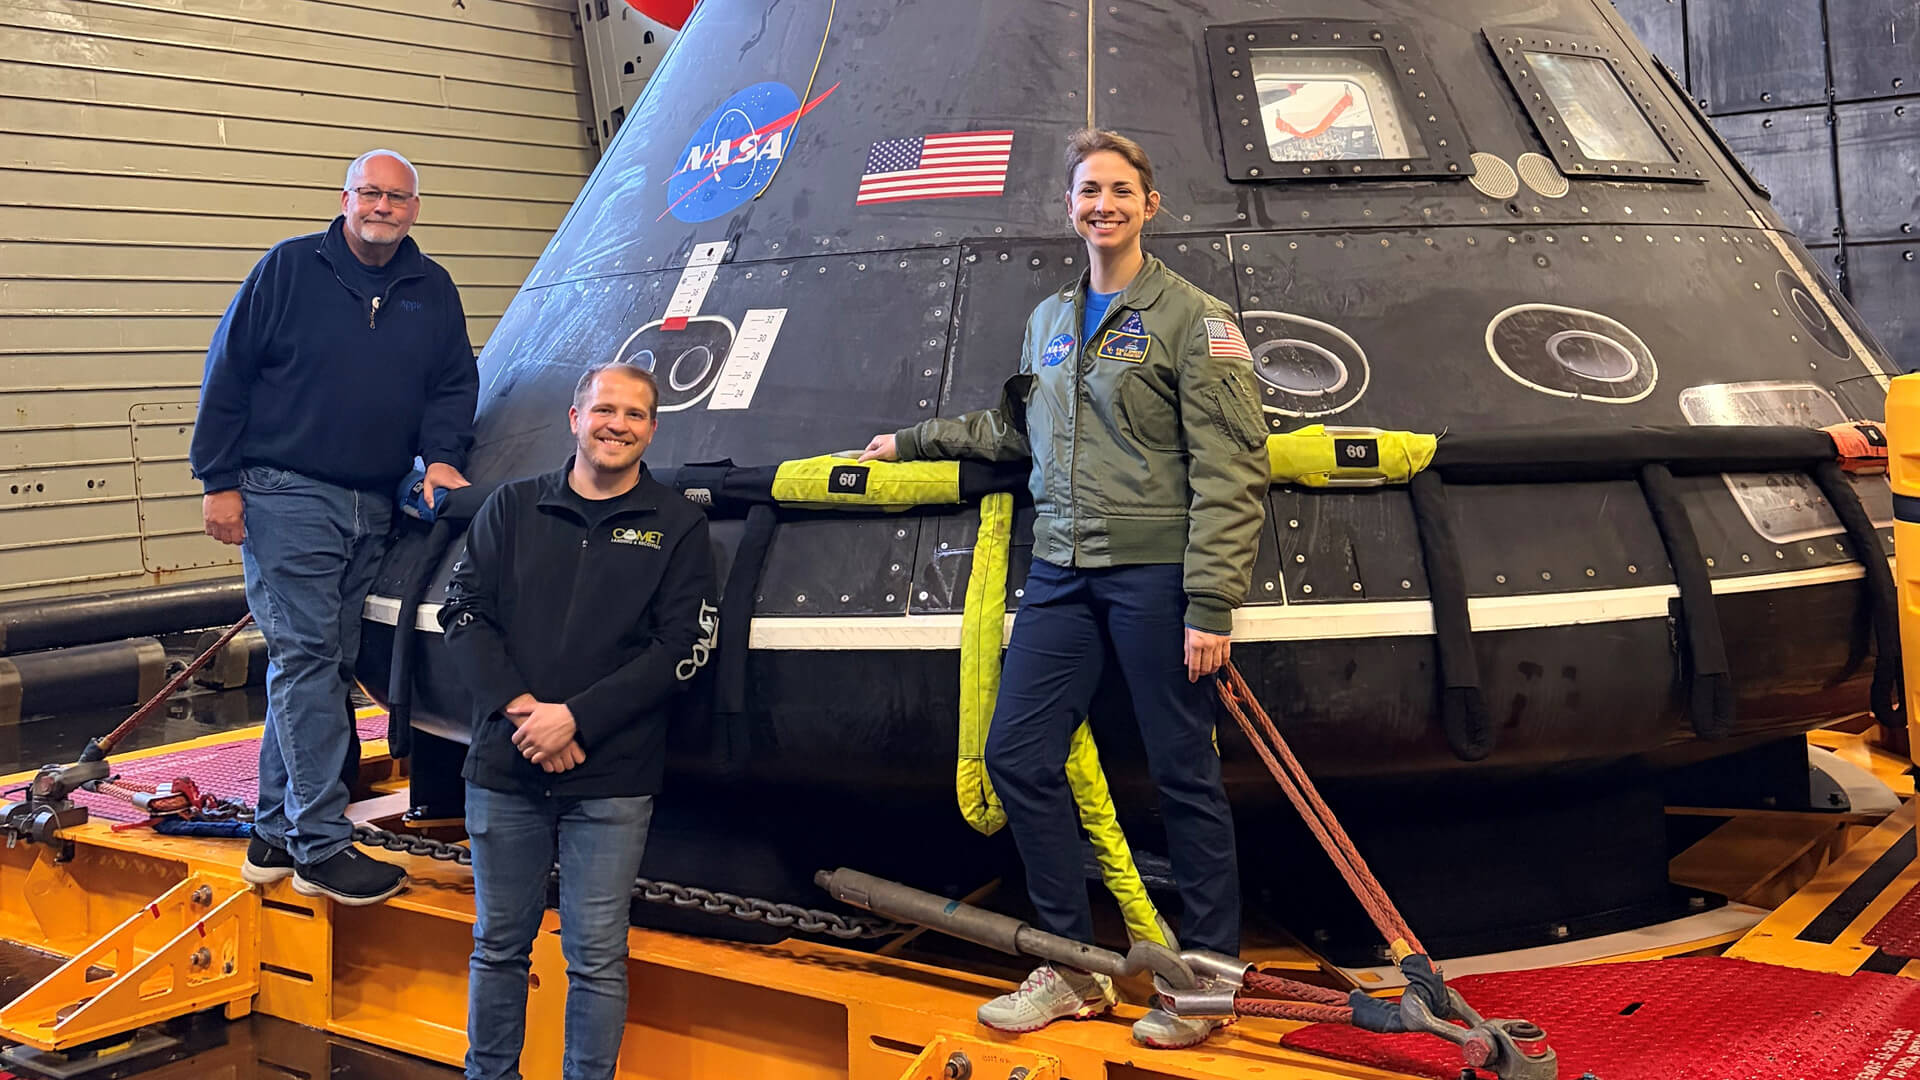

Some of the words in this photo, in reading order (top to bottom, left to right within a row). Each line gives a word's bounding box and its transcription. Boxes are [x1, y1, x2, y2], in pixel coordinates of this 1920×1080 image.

[679, 132, 783, 174] NASA
[1048, 344, 1070, 354] NASA
[612, 528, 664, 545] COMET
